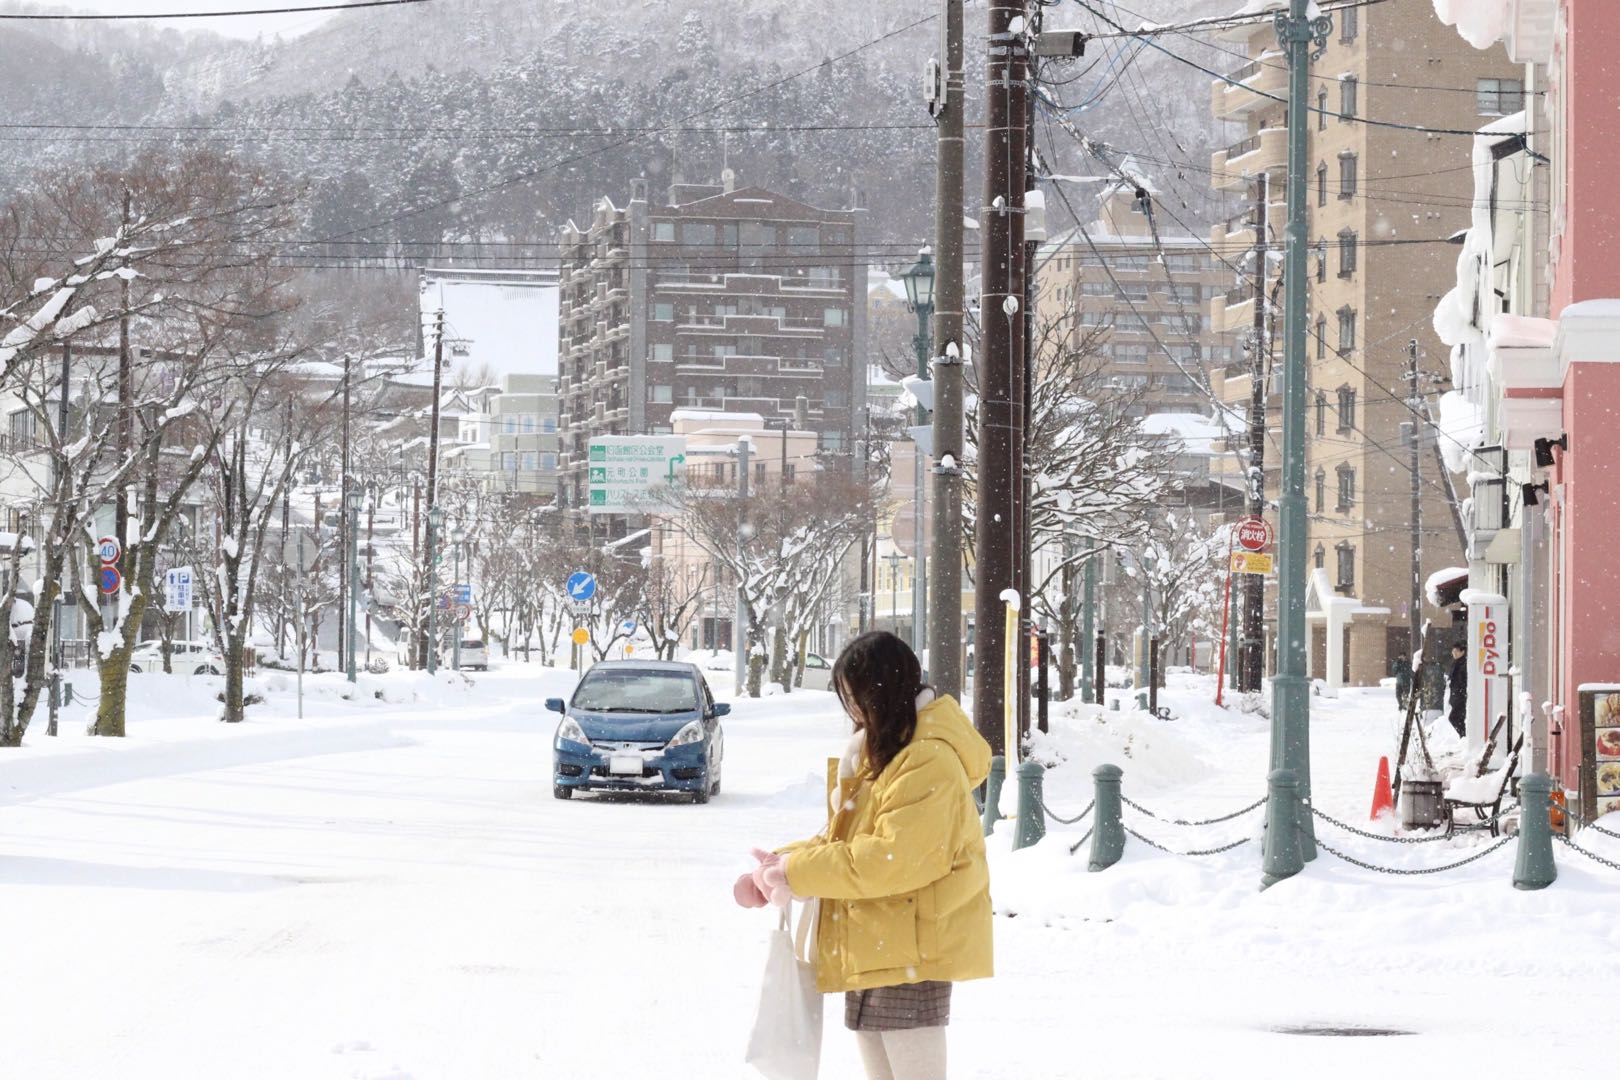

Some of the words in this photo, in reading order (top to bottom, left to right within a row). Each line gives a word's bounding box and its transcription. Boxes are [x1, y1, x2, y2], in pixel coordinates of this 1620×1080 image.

[607, 466, 649, 478] 元町公園
[1240, 529, 1266, 542] 消火栓
[101, 545, 115, 557] 40
[1484, 622, 1499, 675] DyDo
